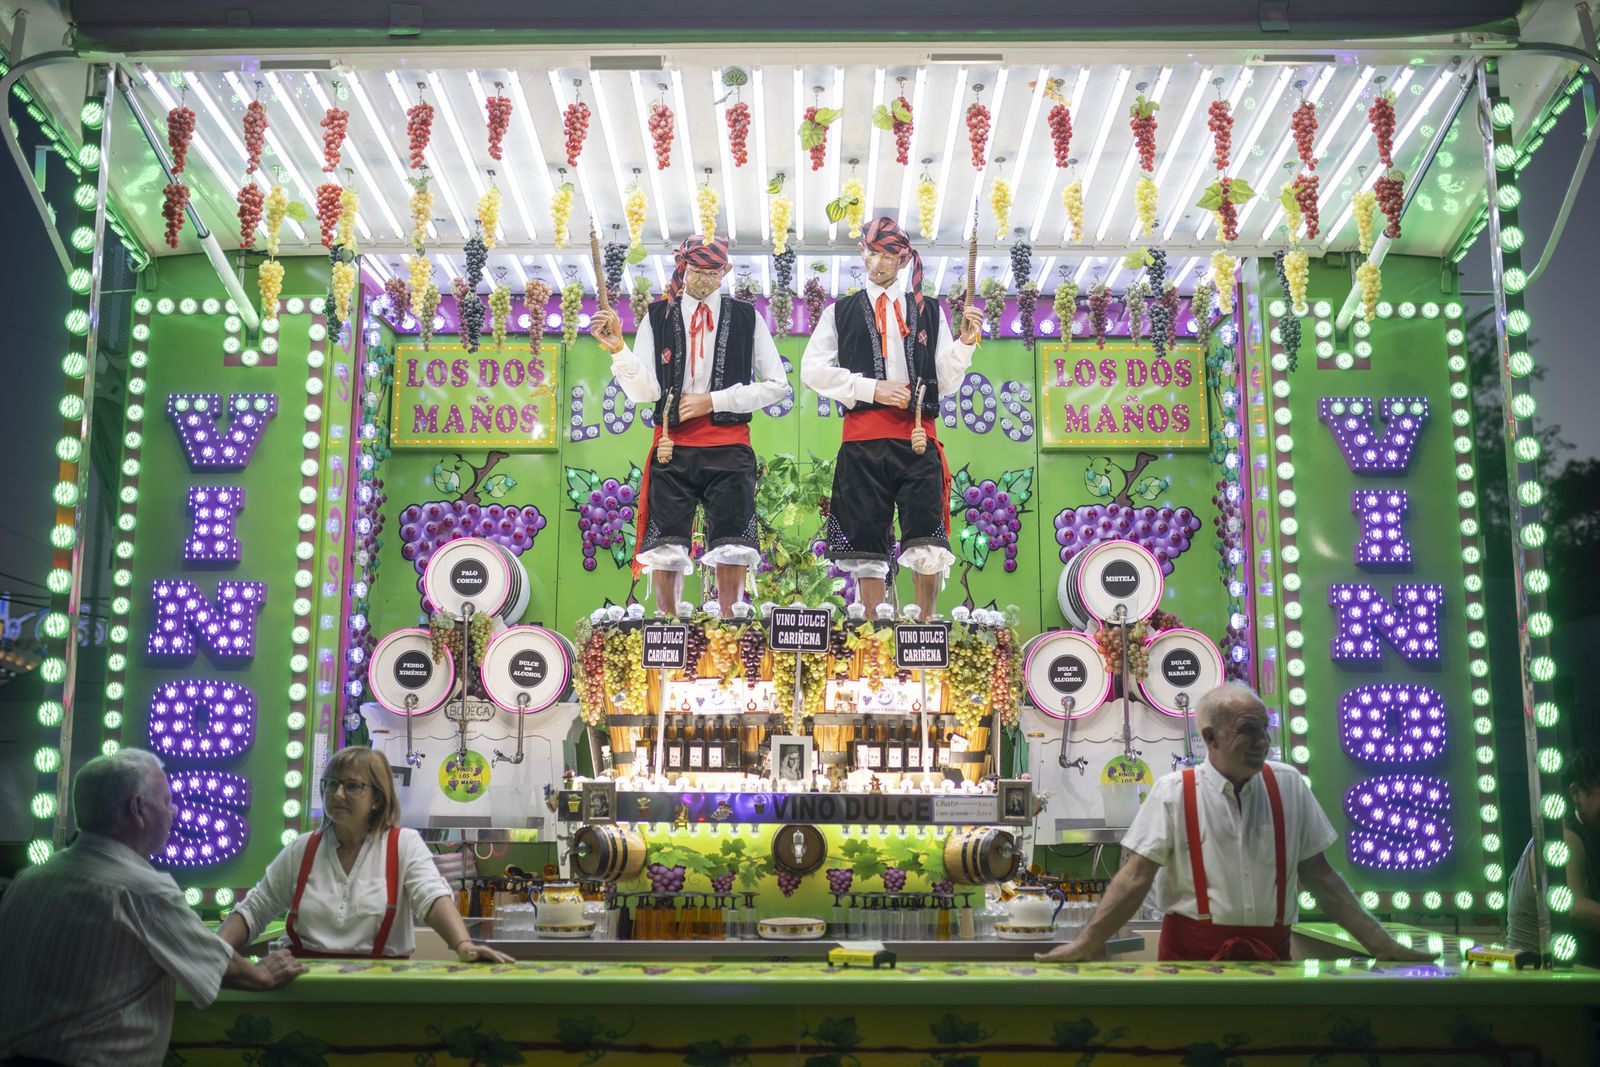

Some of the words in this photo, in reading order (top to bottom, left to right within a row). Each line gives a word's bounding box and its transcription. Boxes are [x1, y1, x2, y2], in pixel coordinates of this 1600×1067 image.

[406, 358, 469, 388] LOS
[478, 358, 545, 388] DOS
[1054, 358, 1117, 388] LOS
[1125, 358, 1193, 388] DOS
[412, 395, 540, 433] MAÑOS
[1064, 395, 1191, 433] MAÑOS
[145, 393, 277, 867] VINOS
[776, 613, 796, 626] VINO
[798, 614, 826, 627] DULCE
[646, 631, 662, 644] VINO
[663, 631, 684, 644] DULCE
[778, 629, 821, 645] CARIÑENA
[899, 631, 918, 644] VINO
[920, 631, 944, 644] DULCE
[1318, 395, 1455, 872] VINOS
[647, 646, 680, 662] CARIÑENA
[903, 646, 942, 662] CARIÑENA
[772, 796, 836, 821] VINO
[846, 796, 931, 822] DULCE
